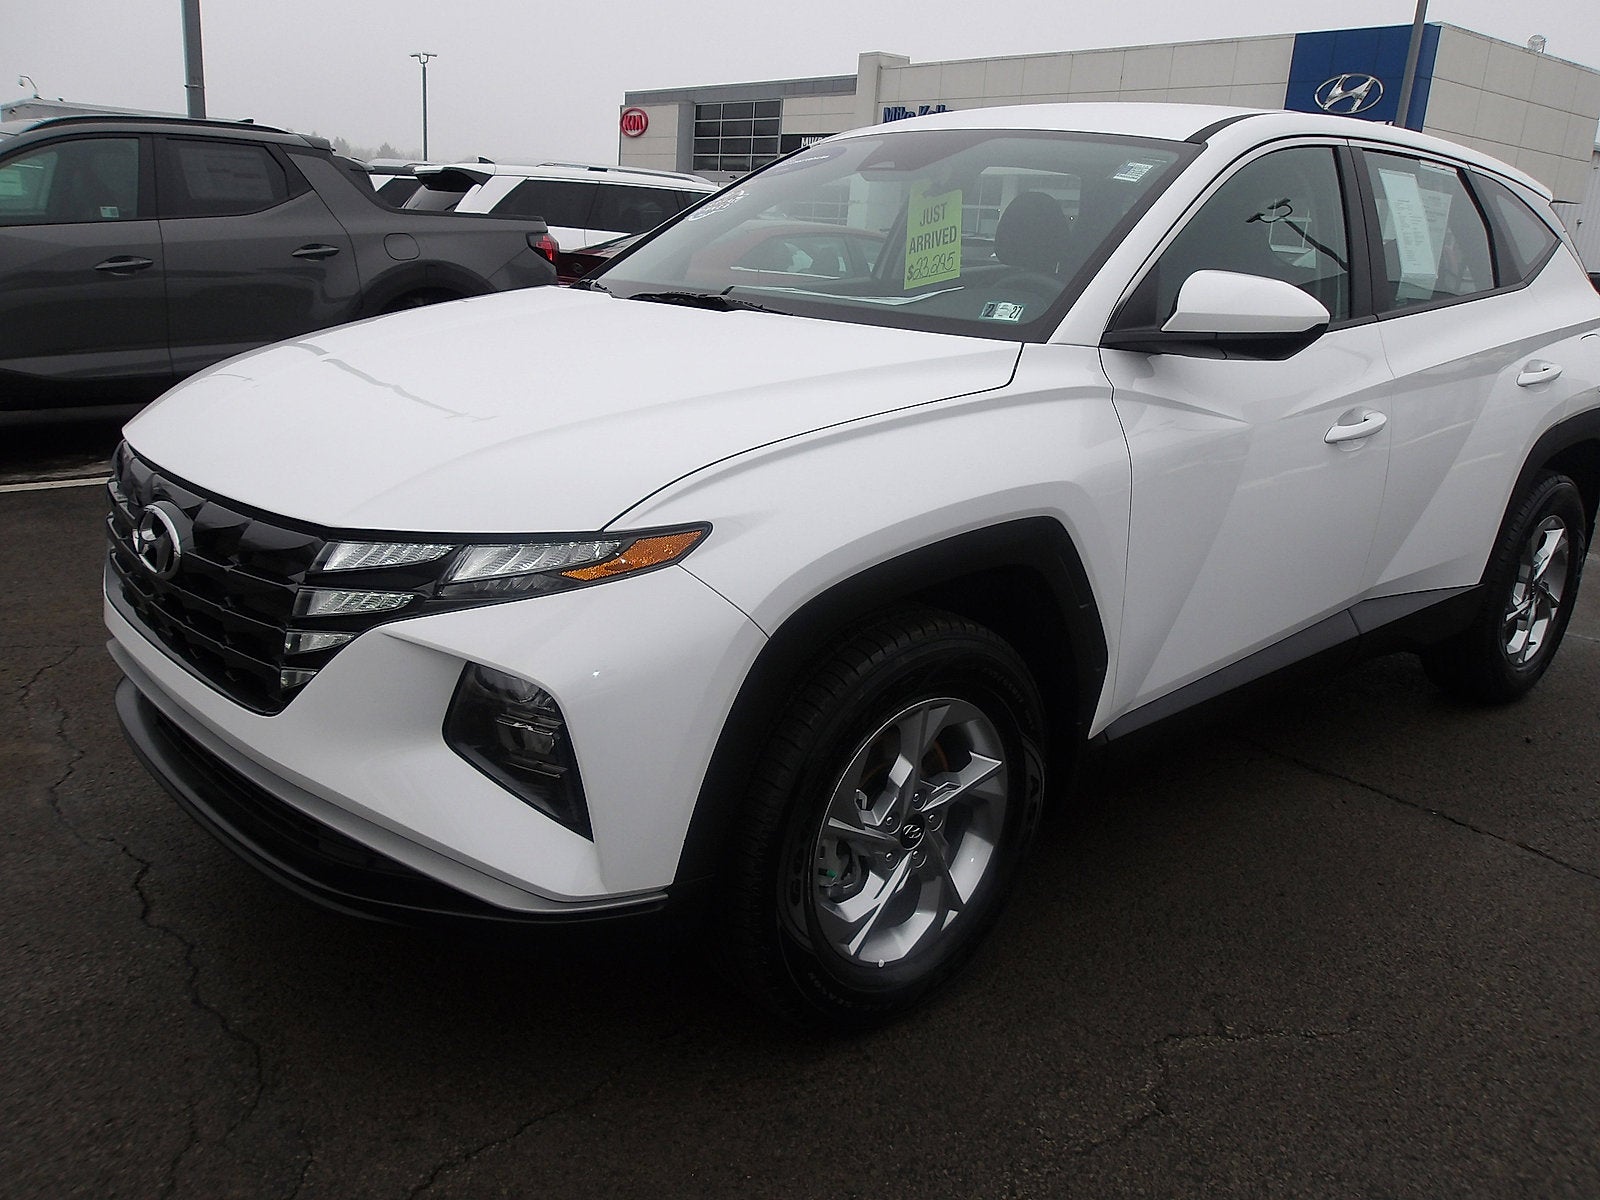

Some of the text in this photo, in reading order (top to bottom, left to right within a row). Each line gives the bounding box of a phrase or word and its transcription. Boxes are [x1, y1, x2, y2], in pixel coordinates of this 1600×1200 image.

[918, 104, 954, 116] Kll
[623, 114, 644, 131] KIA
[801, 137, 823, 148] MIK
[919, 202, 948, 227] JUST
[909, 225, 958, 254] ARRIVED
[1008, 305, 1023, 320] 27
